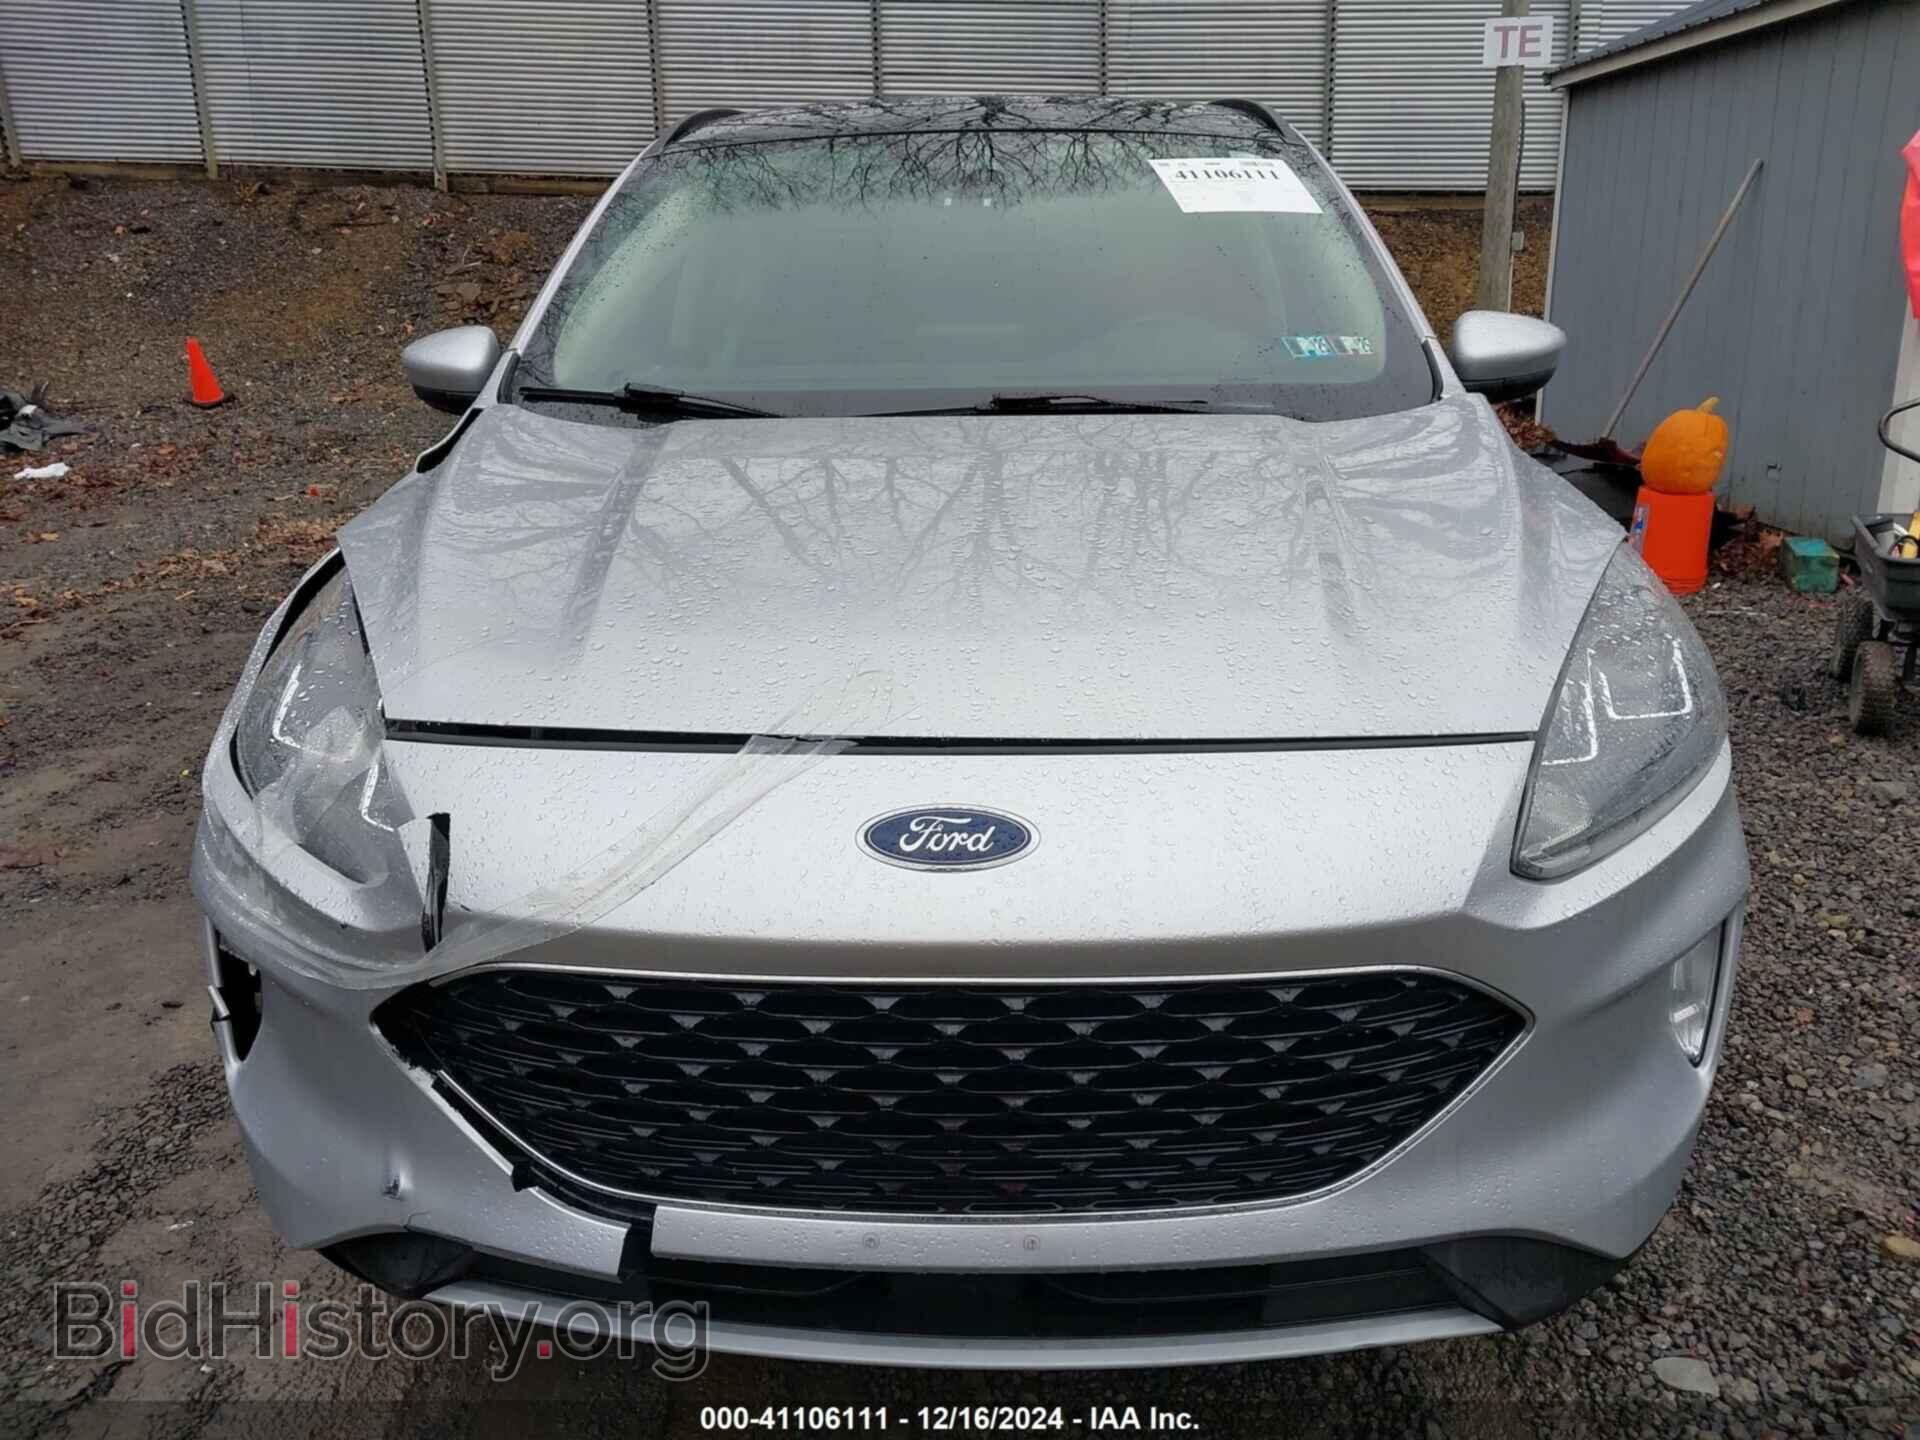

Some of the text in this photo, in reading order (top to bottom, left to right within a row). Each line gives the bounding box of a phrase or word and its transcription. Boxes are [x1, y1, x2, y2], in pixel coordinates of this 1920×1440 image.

[1493, 25, 1543, 58] TE
[1174, 168, 1280, 180] 41106111
[899, 815, 996, 852] Ford
